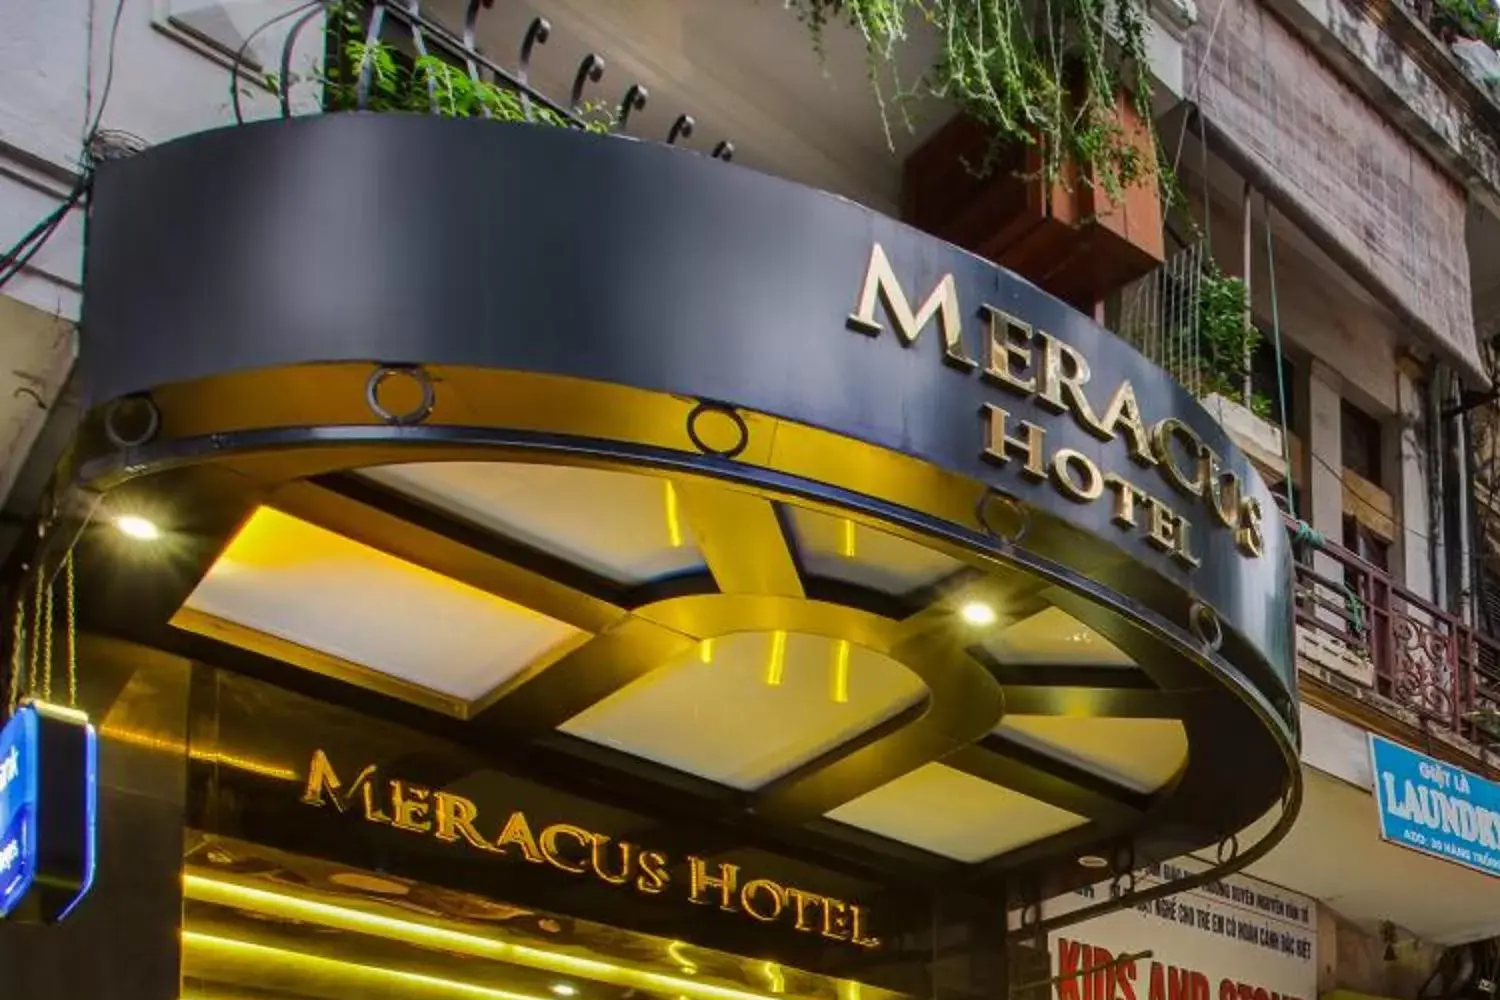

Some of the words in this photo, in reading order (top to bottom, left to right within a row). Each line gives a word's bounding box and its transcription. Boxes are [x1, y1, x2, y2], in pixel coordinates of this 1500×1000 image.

[846, 242, 1264, 558] MERACUS
[979, 402, 1200, 568] HOTEL
[304, 749, 670, 893] MERACUS
[688, 855, 881, 948] HOTEL
